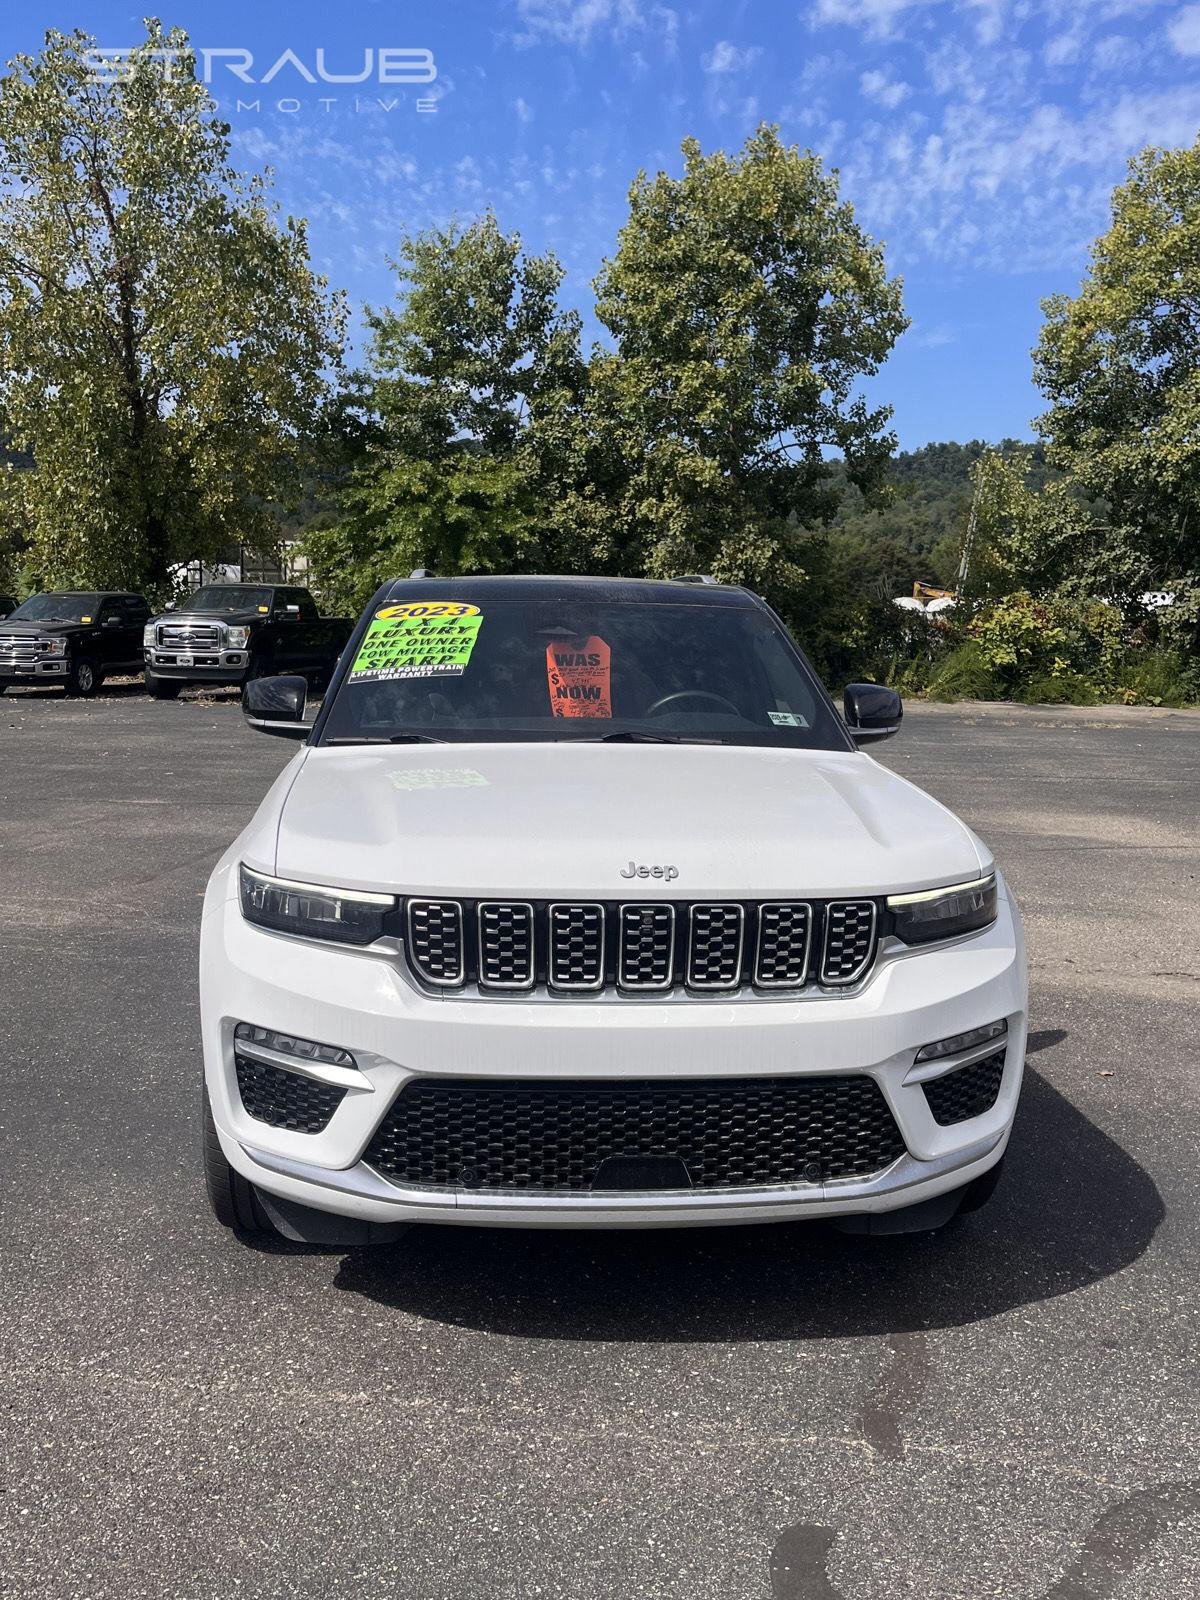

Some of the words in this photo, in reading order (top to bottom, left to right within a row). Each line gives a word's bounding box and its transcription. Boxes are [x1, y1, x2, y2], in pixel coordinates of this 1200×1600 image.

[389, 607, 470, 619] 2023
[390, 619, 407, 629] 4
[444, 617, 461, 626] 4
[369, 626, 475, 639] LUXURY
[363, 640, 402, 650] ONE
[406, 638, 472, 647] OWNER
[359, 649, 392, 659] LOW
[396, 646, 469, 656] MILEAGE
[365, 655, 455, 669] SHARP
[554, 653, 601, 666] WAS
[351, 667, 396, 678] LIFETIME
[397, 664, 464, 673] POWERTRAIN
[378, 671, 434, 680] WARRANTY
[551, 673, 560, 686] $
[556, 687, 602, 700] NOW
[620, 861, 679, 882] Jeep
